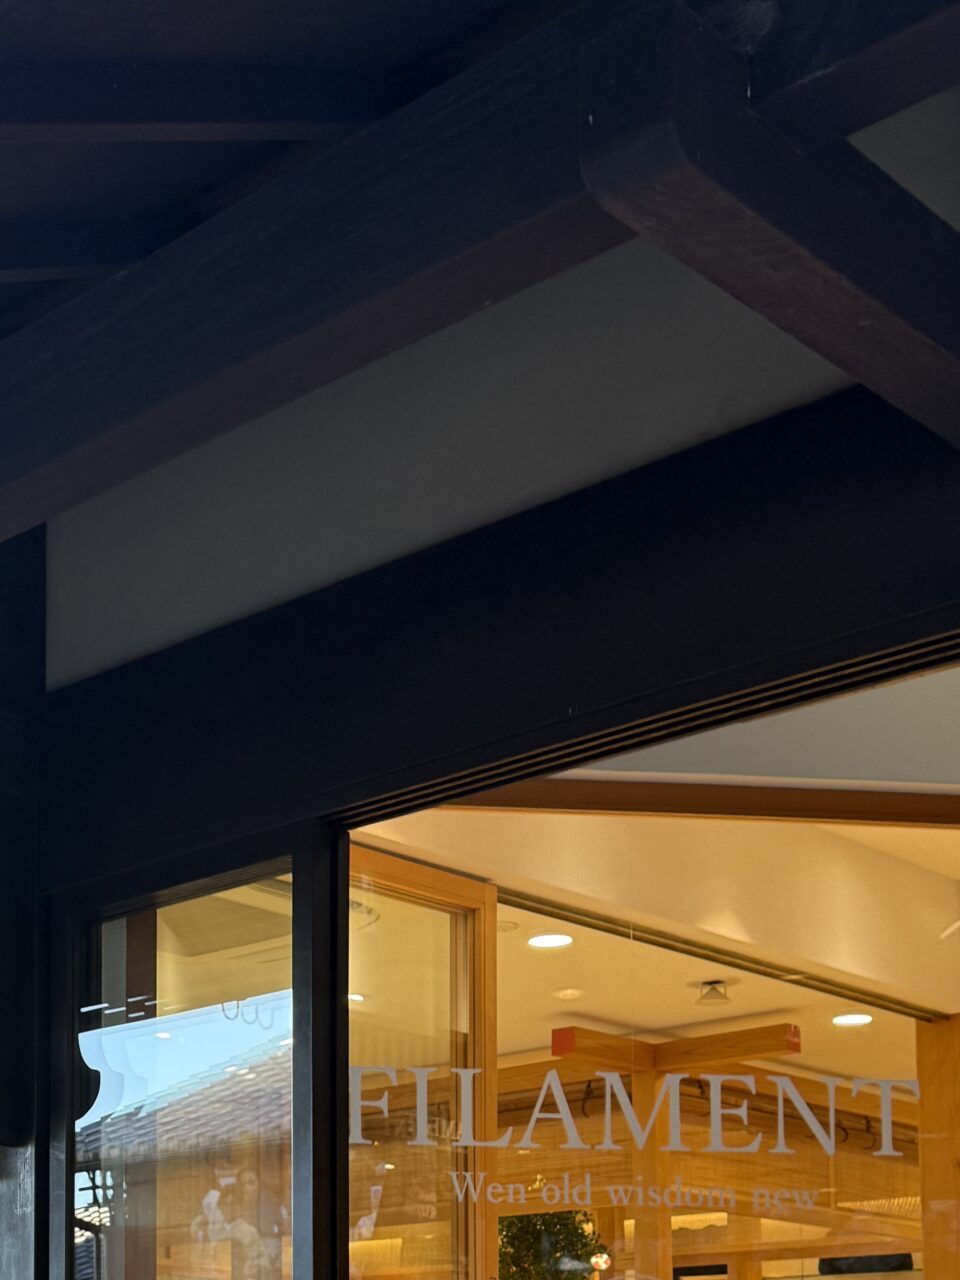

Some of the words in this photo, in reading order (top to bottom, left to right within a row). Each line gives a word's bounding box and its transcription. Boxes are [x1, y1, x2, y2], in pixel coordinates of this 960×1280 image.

[349, 1066, 920, 1157] FILAMENT
[448, 1171, 527, 1204] Wen
[541, 1174, 592, 1207] old
[607, 1176, 737, 1209] wisdom
[752, 1184, 820, 1210] new
